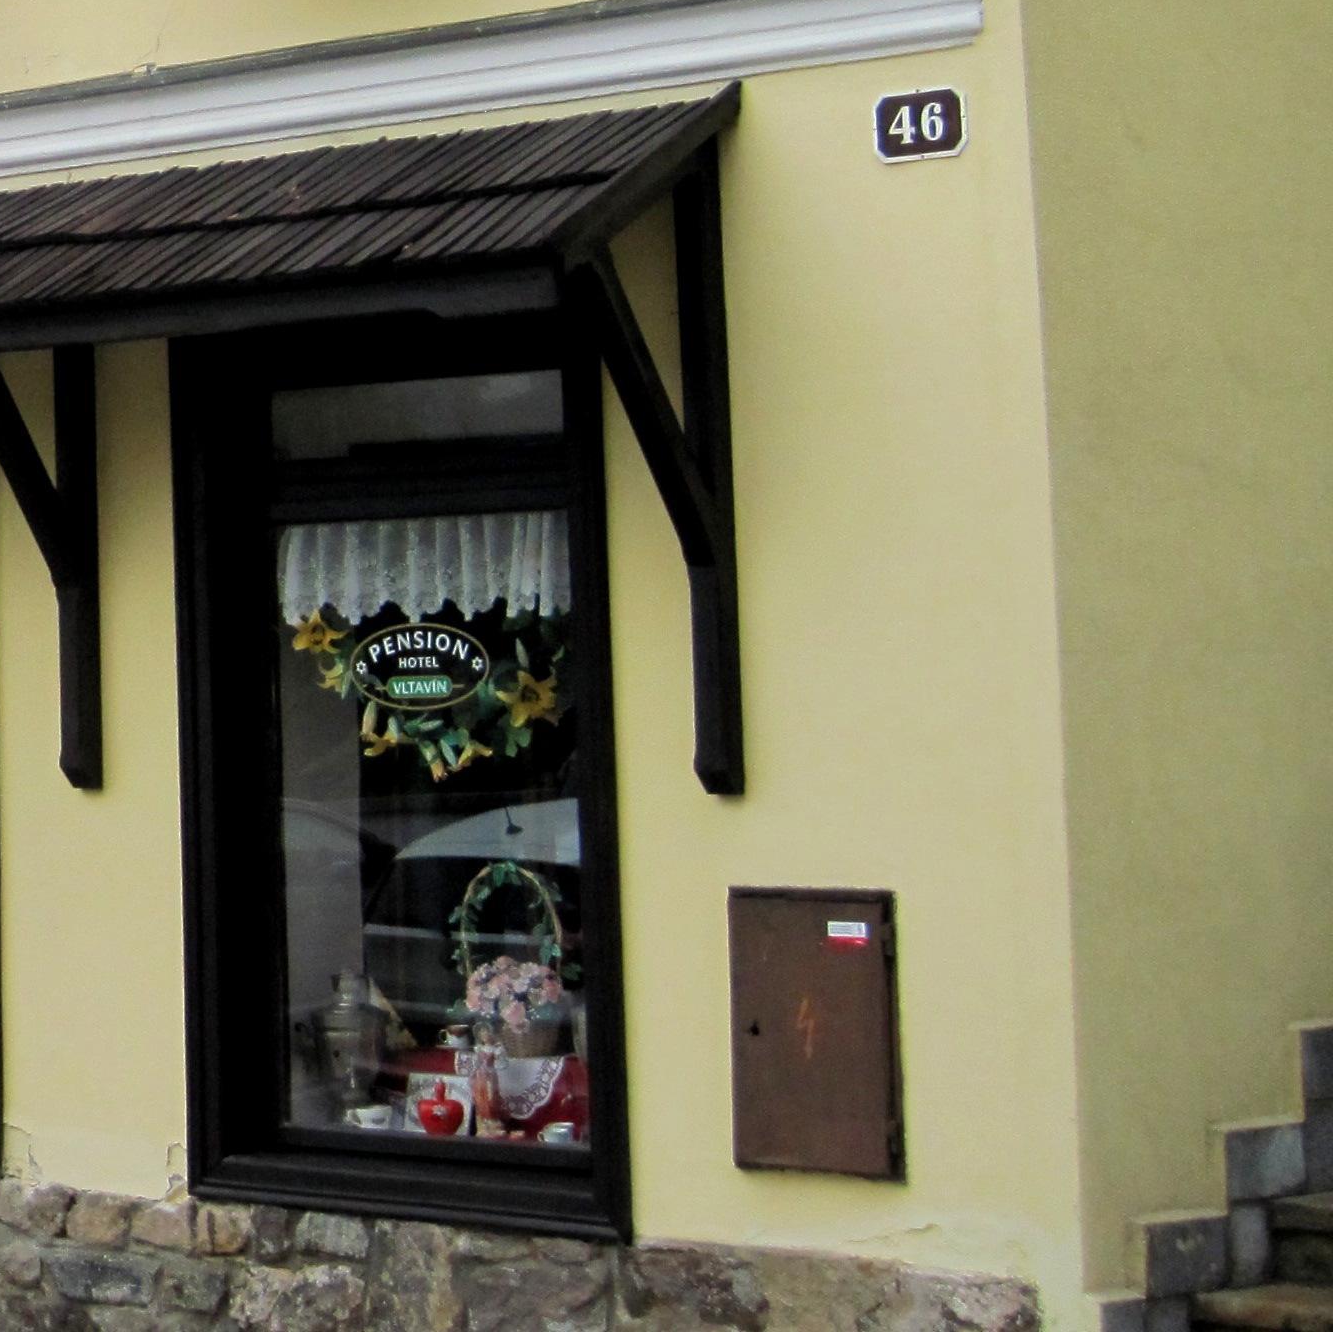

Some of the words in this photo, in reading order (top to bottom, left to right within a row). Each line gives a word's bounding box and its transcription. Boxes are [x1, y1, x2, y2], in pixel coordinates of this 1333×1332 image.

[888, 102, 944, 145] 46
[367, 631, 470, 662] PENSION
[398, 656, 439, 669] HOTEL
